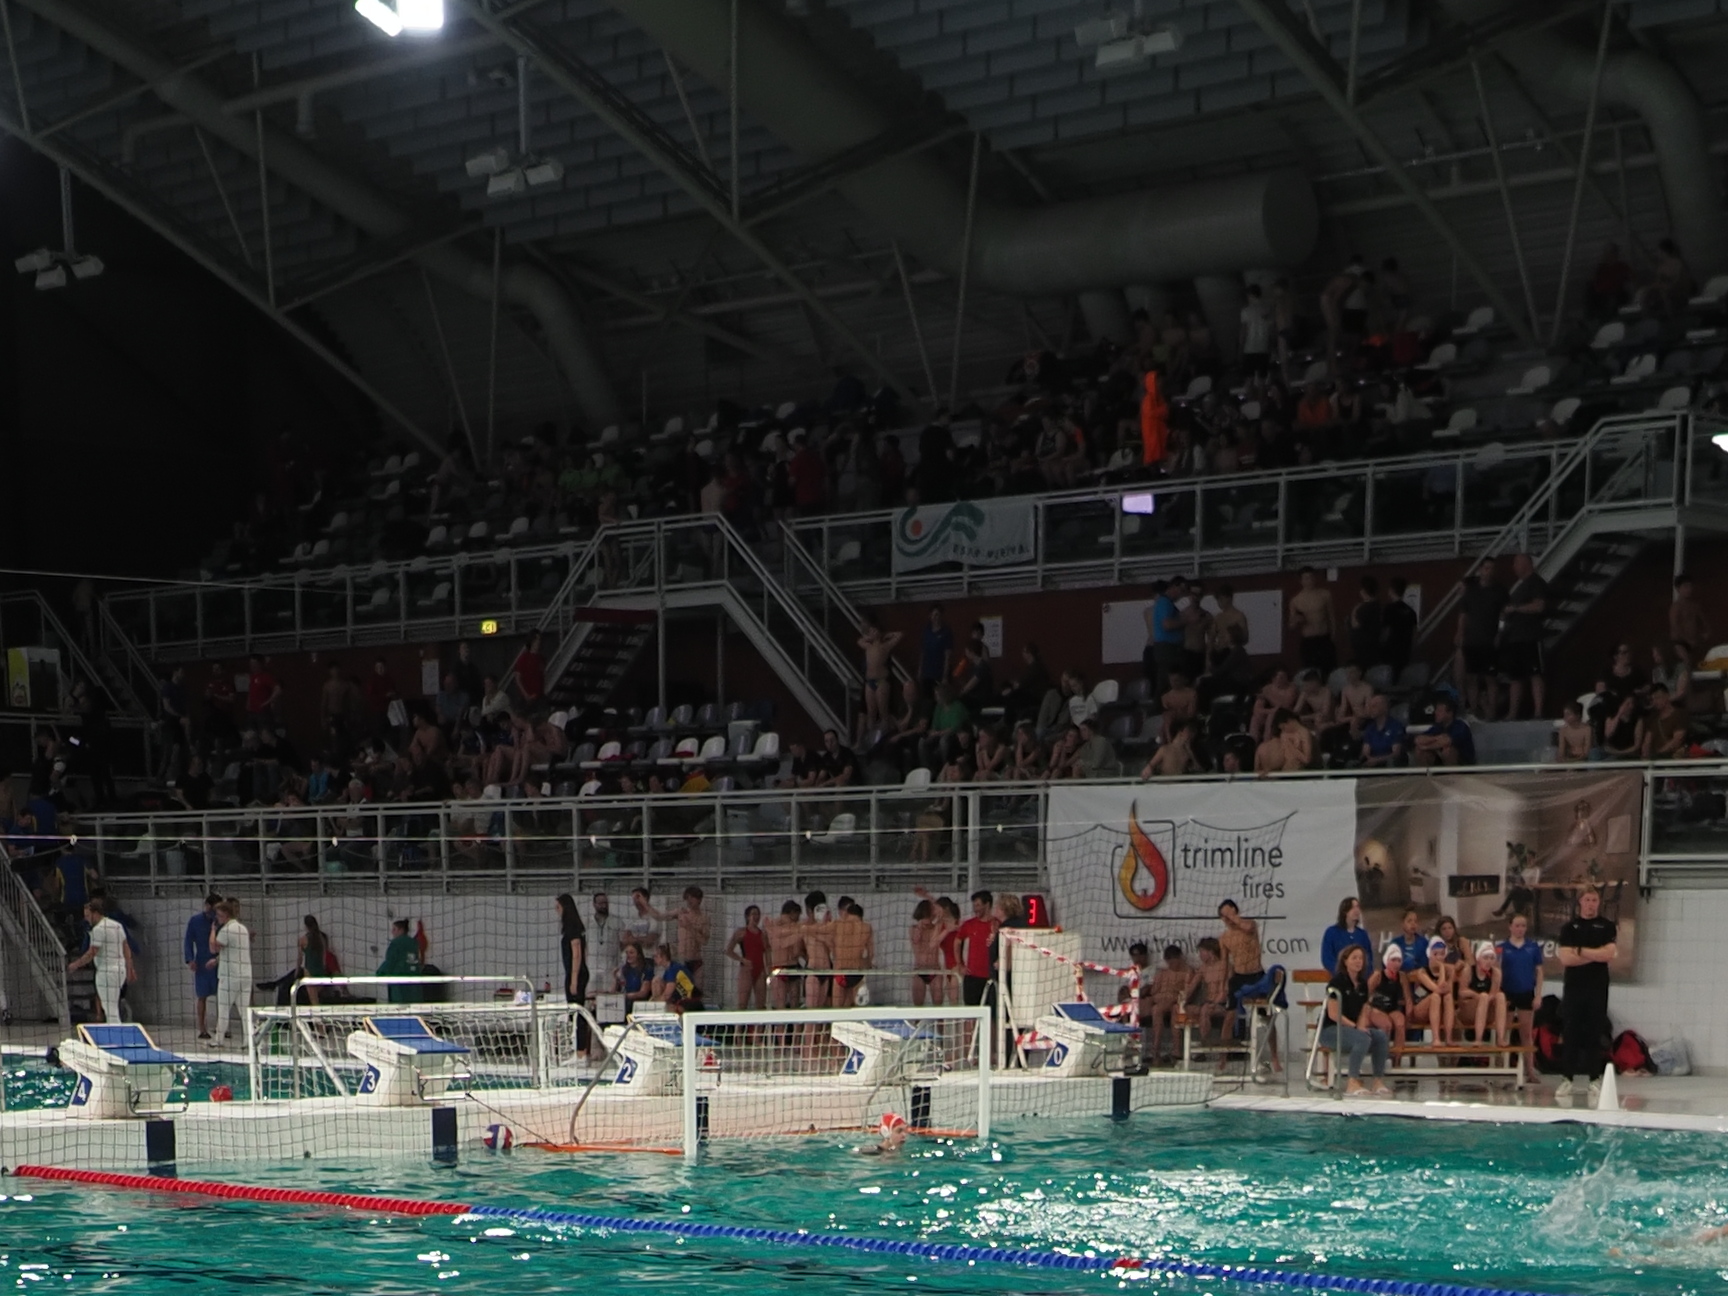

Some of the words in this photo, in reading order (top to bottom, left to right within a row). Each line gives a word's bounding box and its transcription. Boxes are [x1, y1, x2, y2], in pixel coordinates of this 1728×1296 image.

[1181, 835, 1284, 869] trimline
[1241, 874, 1286, 899] fires
[1028, 898, 1037, 924] 3
[366, 1072, 376, 1092] 3
[622, 1063, 632, 1082] 2
[77, 1082, 87, 1102] 4
